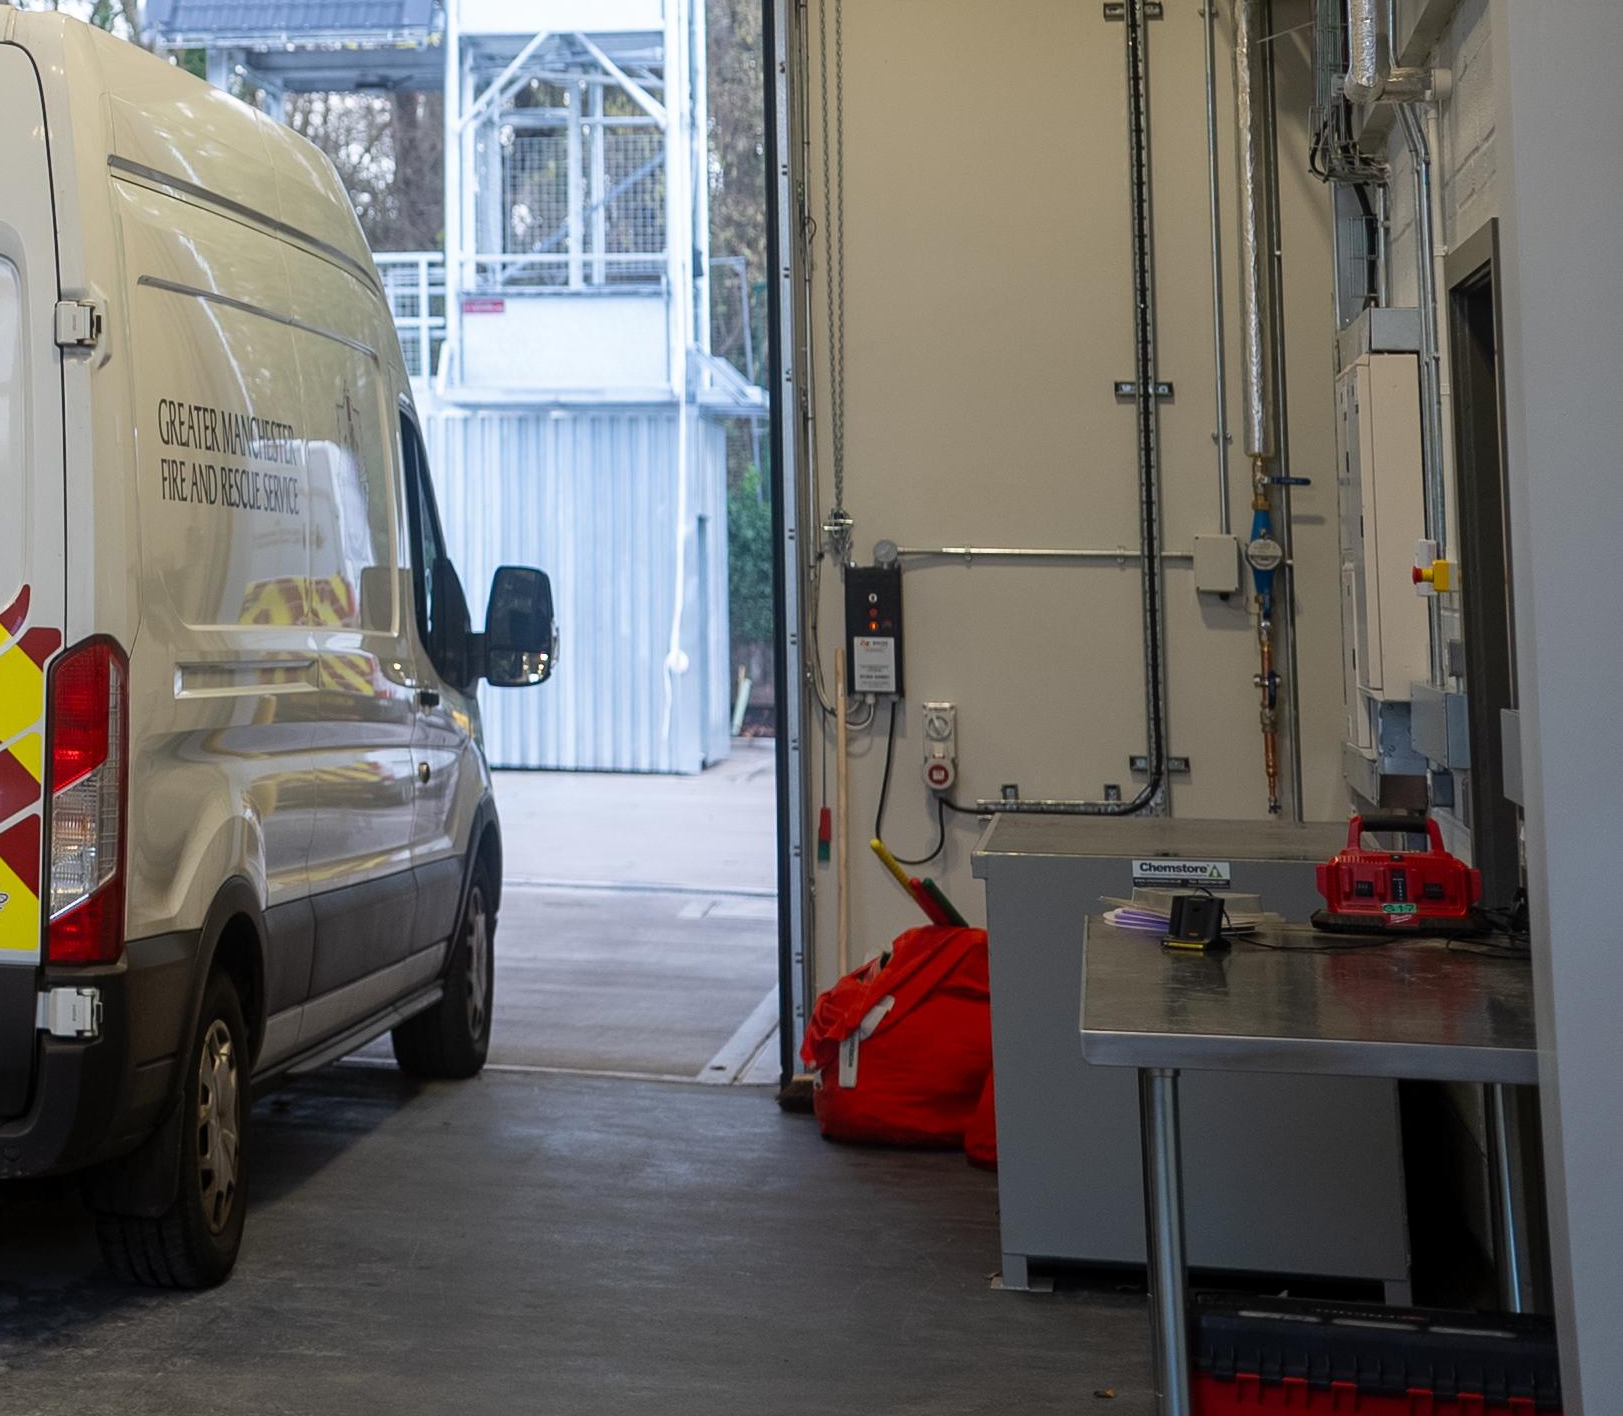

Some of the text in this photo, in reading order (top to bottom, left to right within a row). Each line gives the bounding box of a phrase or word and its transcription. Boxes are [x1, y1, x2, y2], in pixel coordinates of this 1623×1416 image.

[158, 399, 298, 467] GREATER MANCHESTER
[161, 458, 300, 516] FIRE AND RESCUE SERVICE
[1139, 862, 1208, 874] Chemstore
